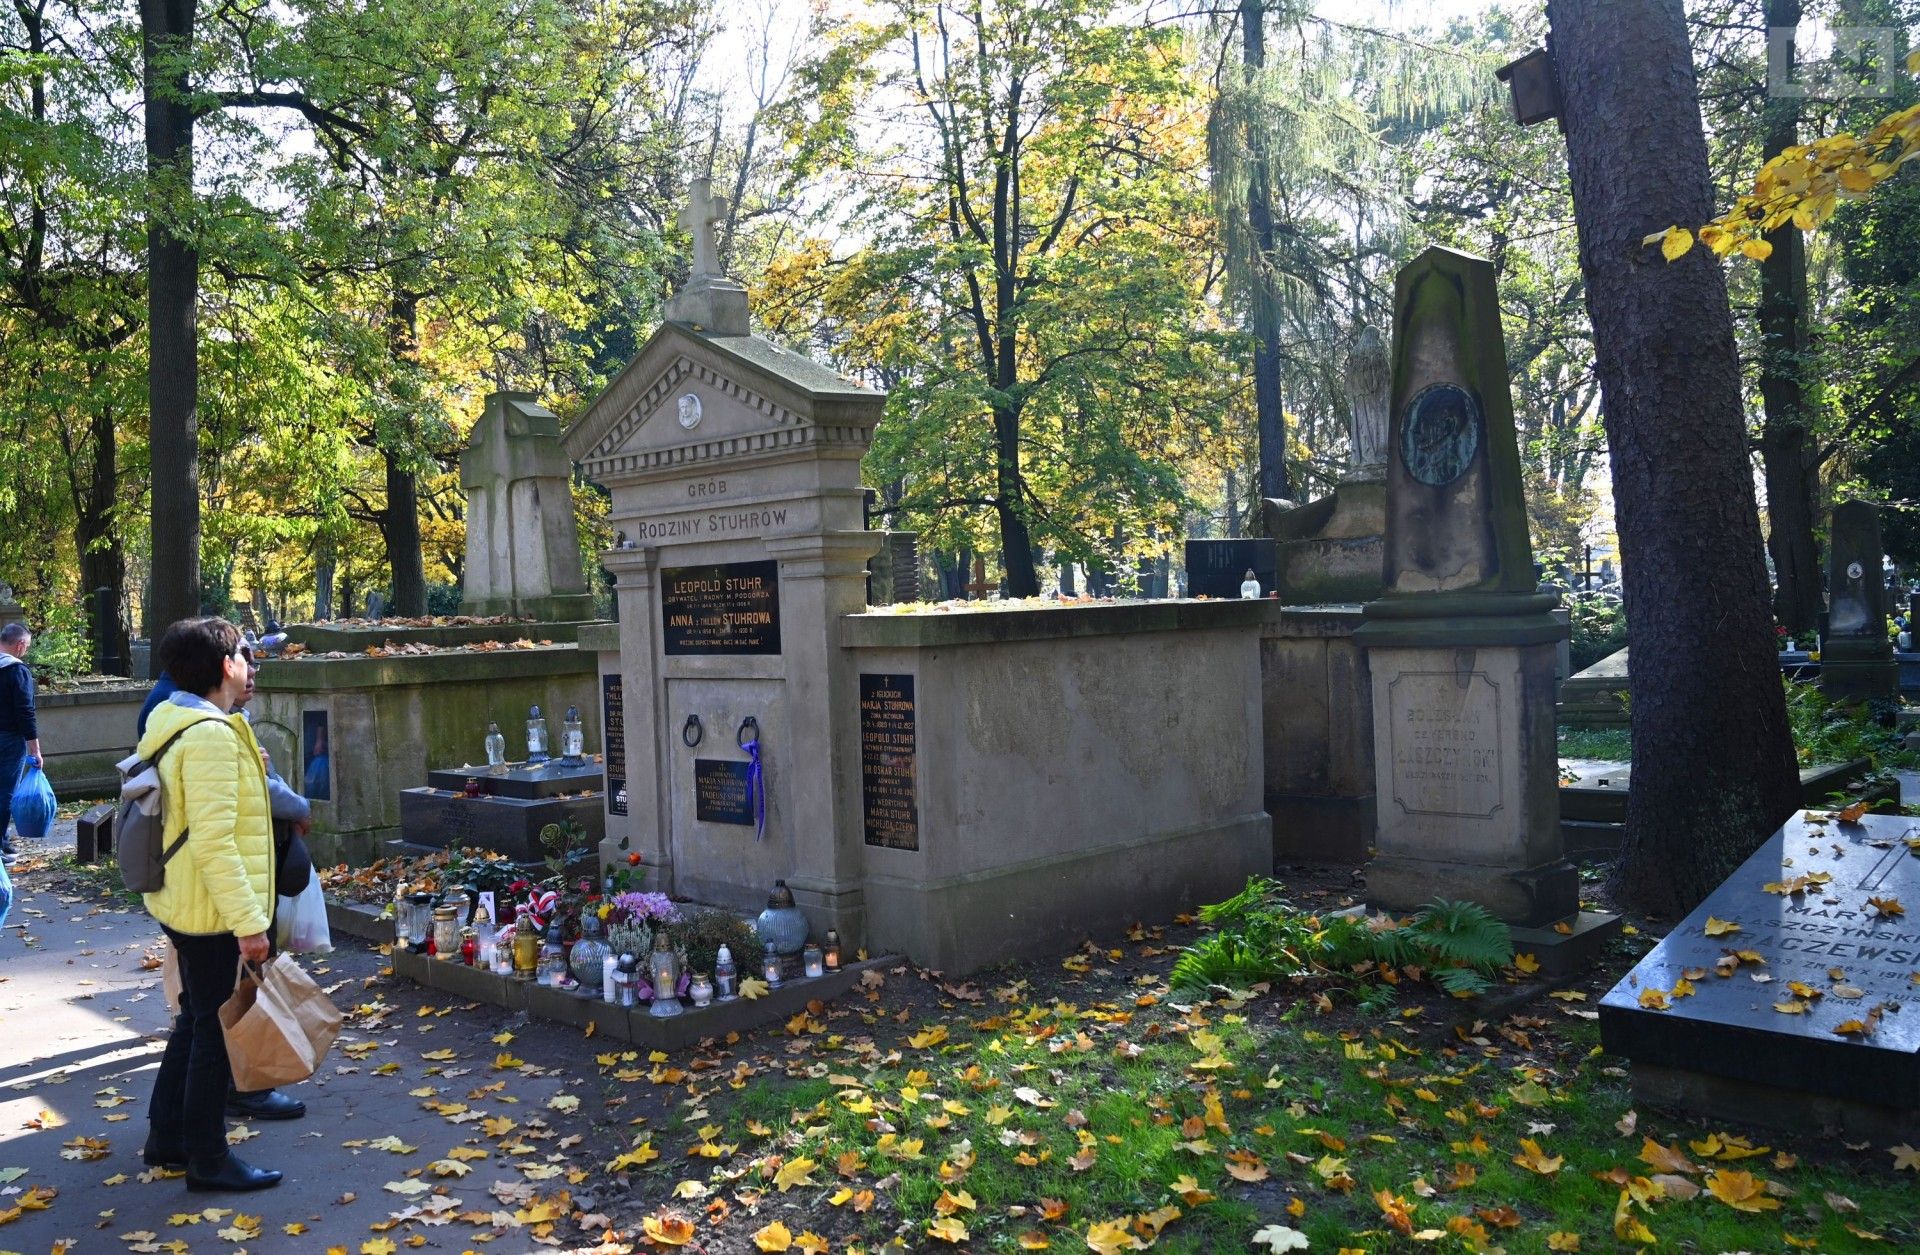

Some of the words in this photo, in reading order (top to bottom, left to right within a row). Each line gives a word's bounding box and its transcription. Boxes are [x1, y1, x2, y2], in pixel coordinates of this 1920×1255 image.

[688, 478, 727, 497] GRÓB
[639, 519, 700, 540] RODZINY
[708, 507, 787, 531] STUHRÓW
[674, 580, 721, 594] LEOPOLD
[726, 576, 762, 591] STUHR
[670, 615, 694, 627] ANNA
[722, 612, 771, 625] STUHROWA
[862, 732, 890, 743] LEOPOLD
[892, 734, 914, 744] STUHR
[873, 765, 892, 775] OSKAR
[890, 809, 911, 820] STUHR
